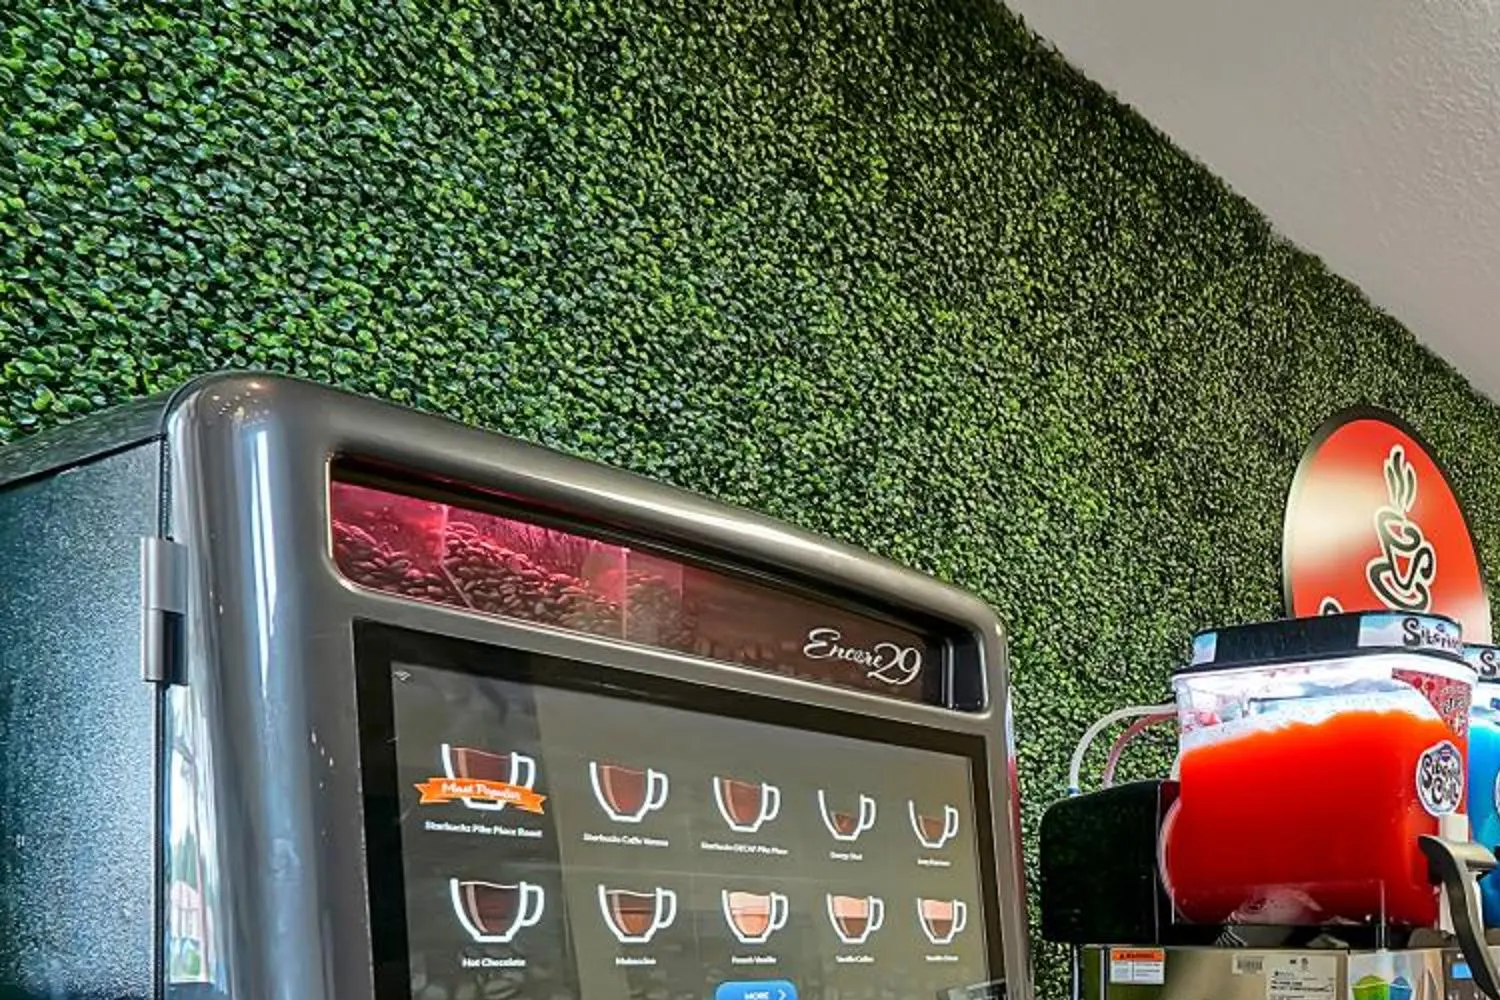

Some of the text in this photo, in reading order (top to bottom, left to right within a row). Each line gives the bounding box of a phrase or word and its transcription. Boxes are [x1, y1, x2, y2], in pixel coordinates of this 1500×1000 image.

[441, 781, 473, 794] Most
[425, 820, 471, 833] Starbucks
[462, 957, 525, 968] Hot Chocolate
[744, 991, 769, 1000] MORE
